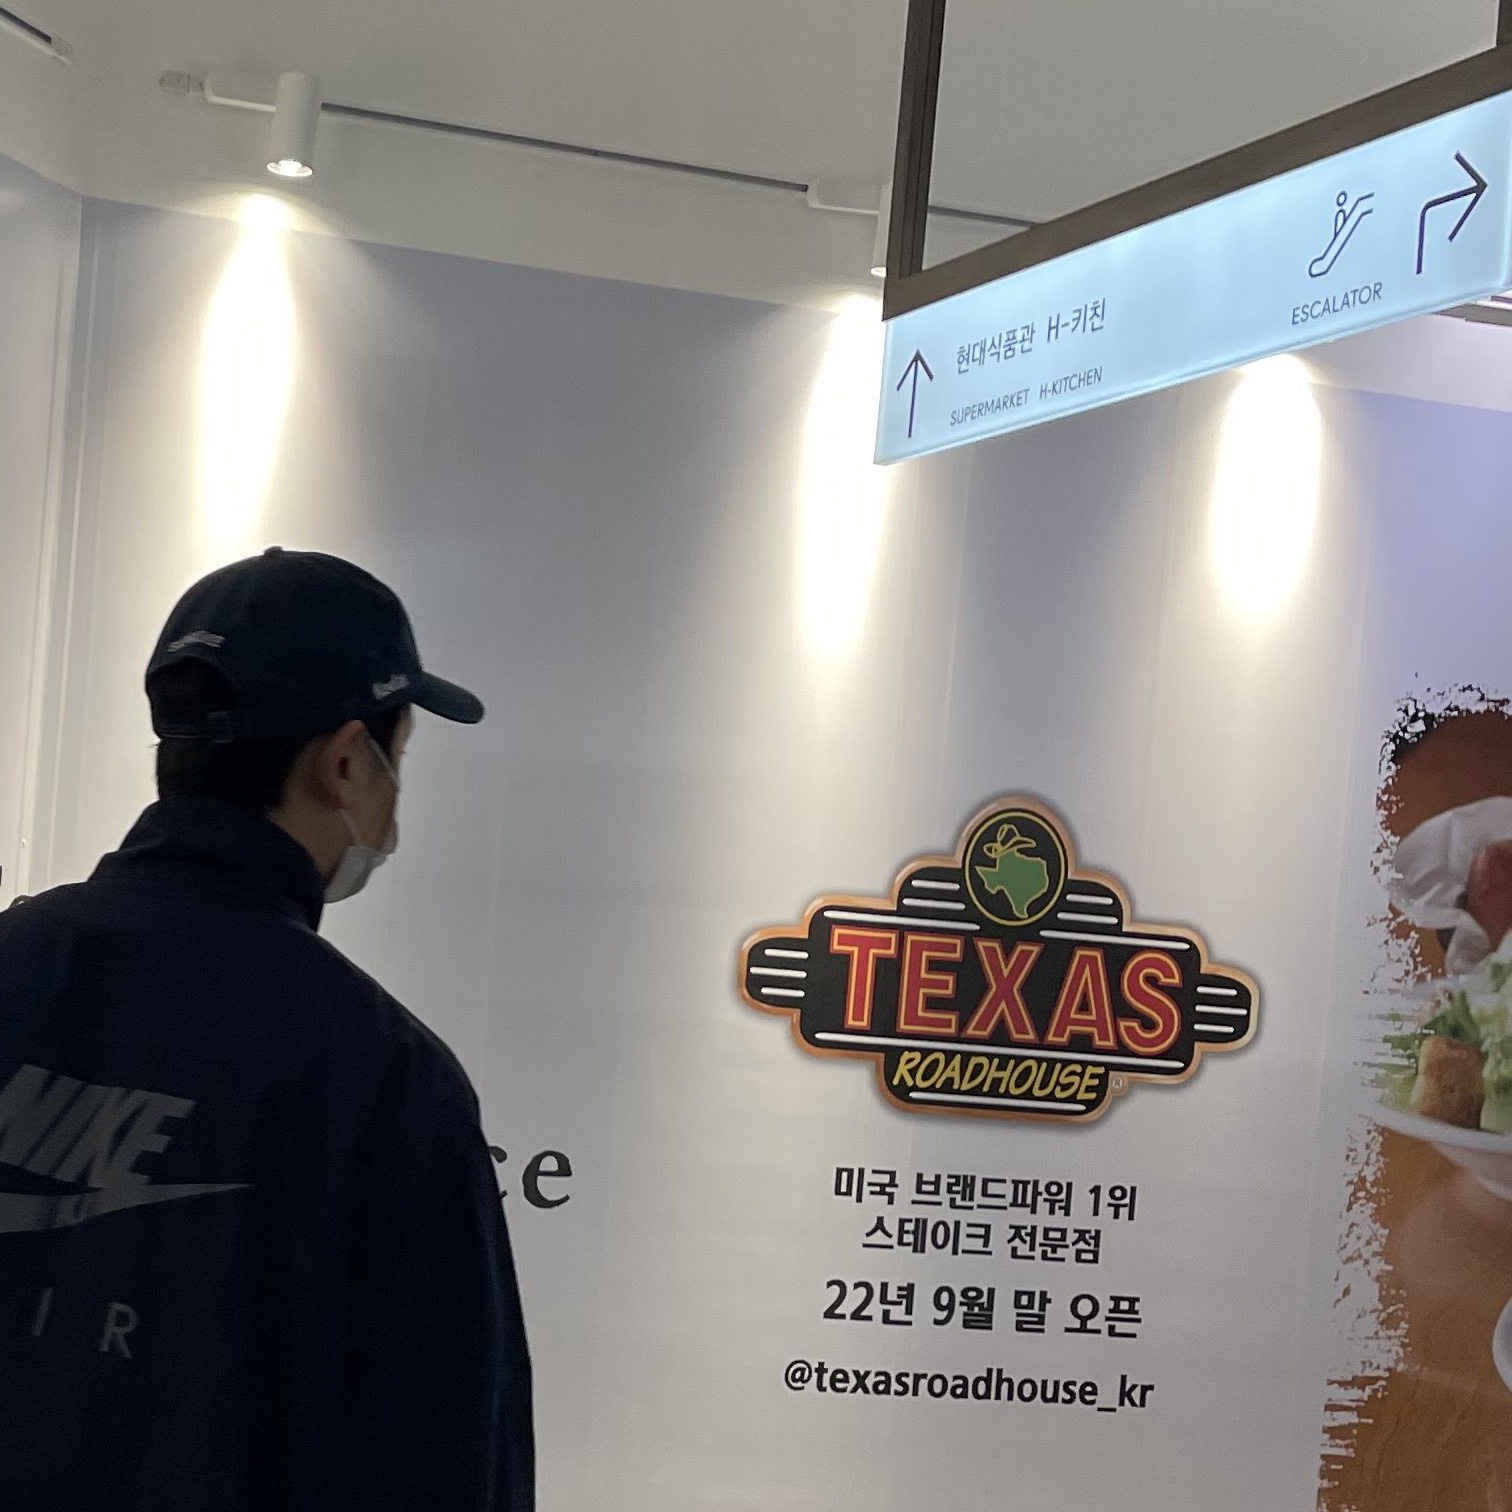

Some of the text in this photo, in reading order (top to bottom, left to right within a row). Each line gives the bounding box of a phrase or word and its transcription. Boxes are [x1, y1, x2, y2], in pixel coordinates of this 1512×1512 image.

[1291, 282, 1383, 325] ESCALATOR
[956, 297, 1106, 375] 현대식품관 H-키친
[950, 365, 1103, 426] SUPERMARKET H-KITCHEN
[829, 924, 1184, 1057] TEXAS
[891, 1050, 1106, 1102] ROADHOUSE
[833, 1166, 1138, 1221] 미국 브랜드파워 1위
[862, 1216, 1102, 1264] 스테이크 전문점
[822, 1279, 1143, 1339] 22년 9월 말 오픈
[784, 1359, 1155, 1414] @texasroadhouse_kr
